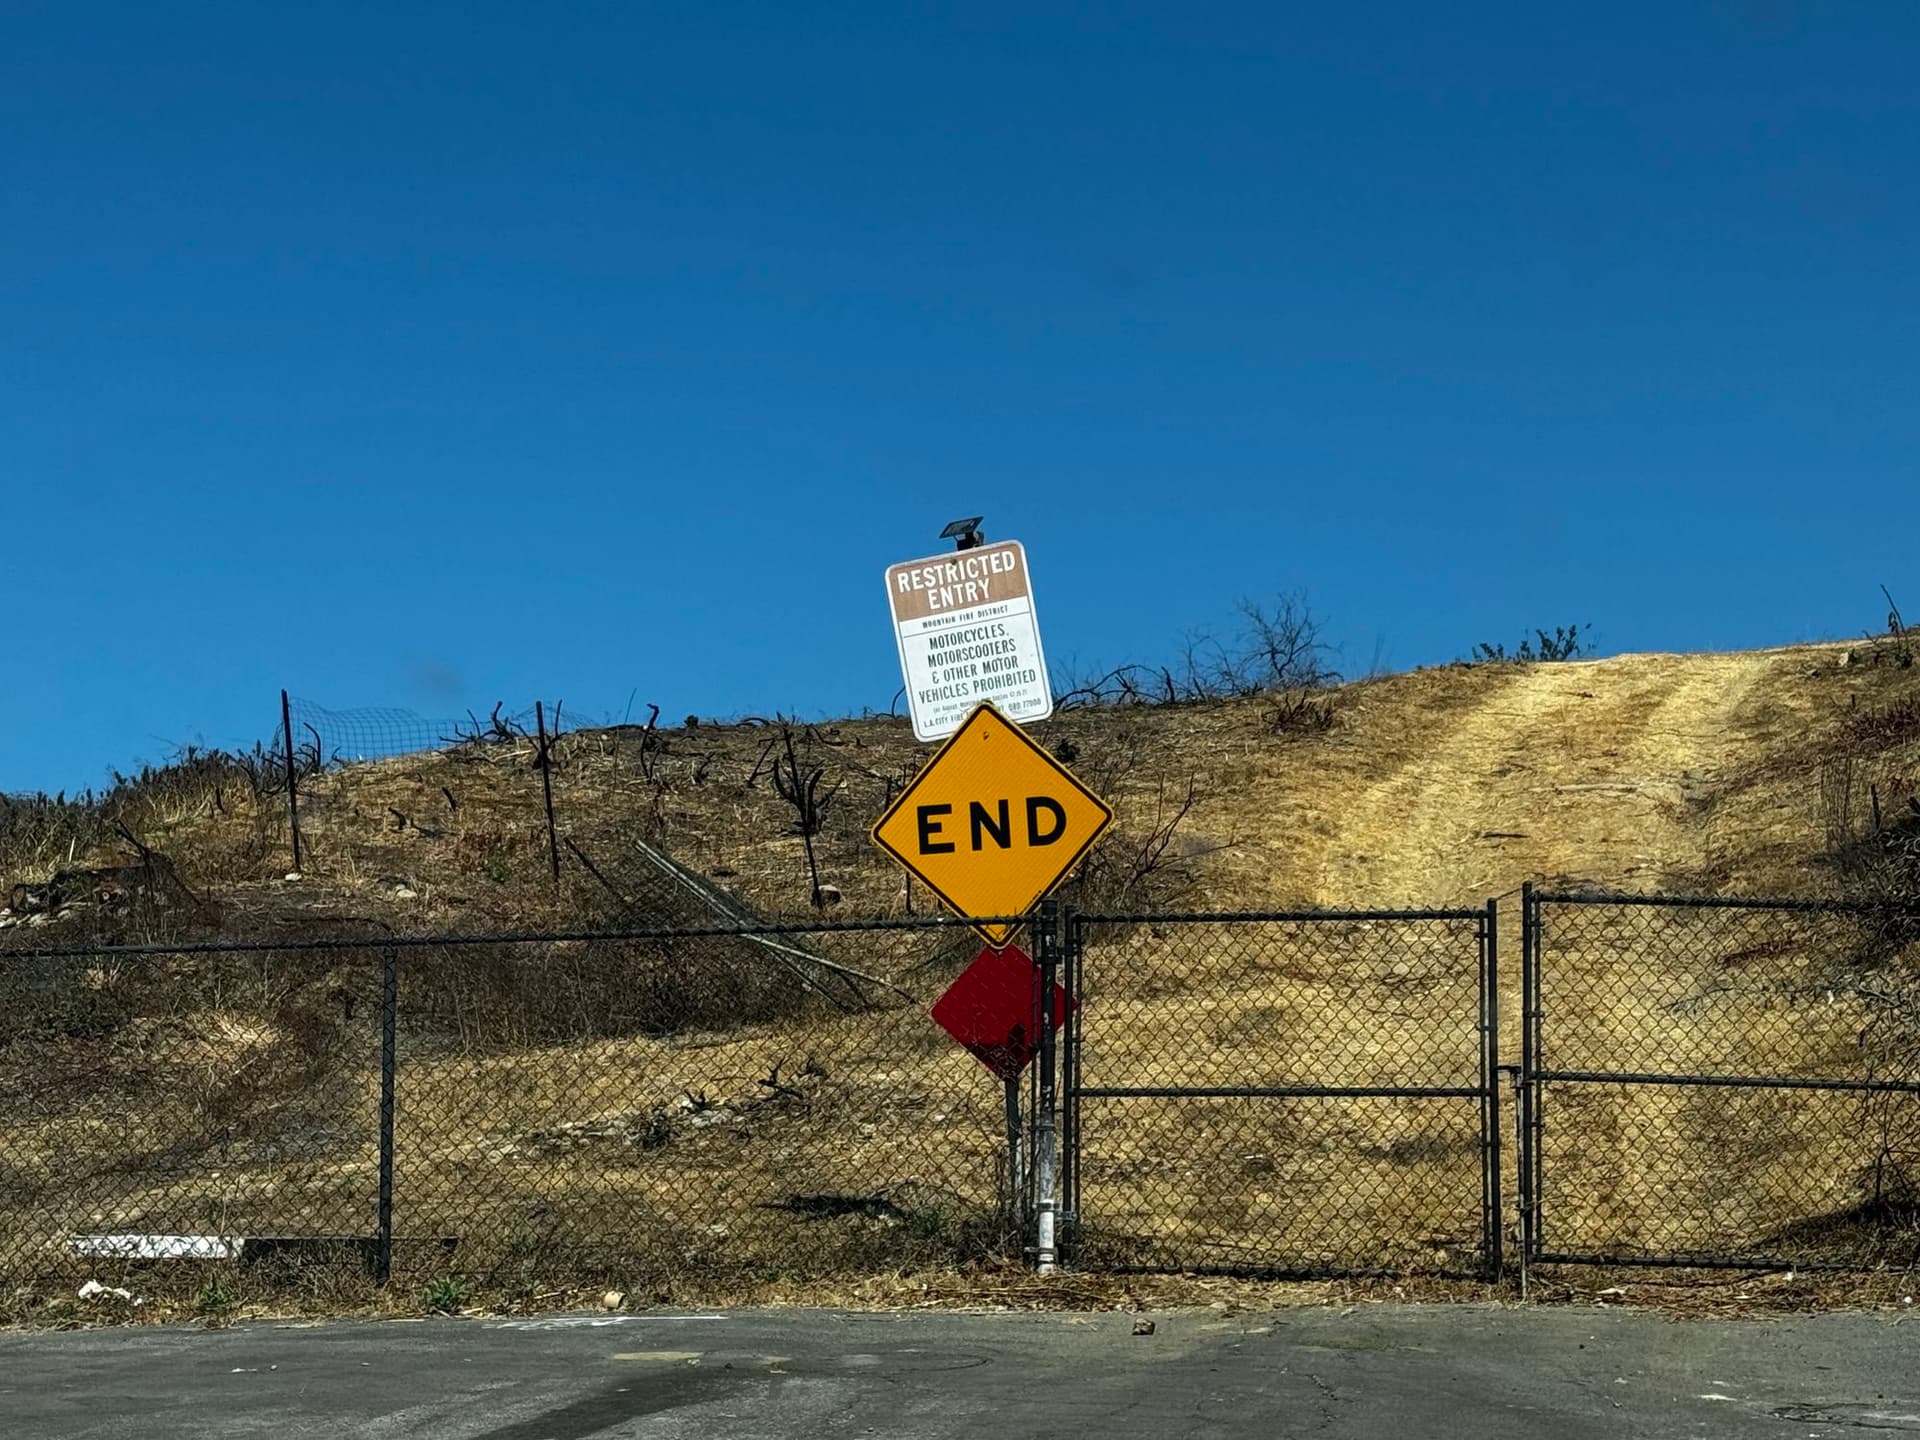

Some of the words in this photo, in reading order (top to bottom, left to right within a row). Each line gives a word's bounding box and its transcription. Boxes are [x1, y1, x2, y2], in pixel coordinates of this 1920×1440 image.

[897, 550, 1016, 593] RESTRICTED
[927, 577, 990, 610] ENTRY
[922, 615, 956, 629] MOUNTAIN
[959, 611, 974, 623] FIRE
[977, 605, 1008, 618] DISTRICT
[927, 638, 1017, 668] MOTORSCOOTERS
[943, 663, 978, 682] OTHER
[982, 655, 1019, 675] MOTOR
[919, 682, 969, 704] VEHICLES
[973, 669, 1036, 694] PROHIBITED
[917, 796, 1067, 855] END
